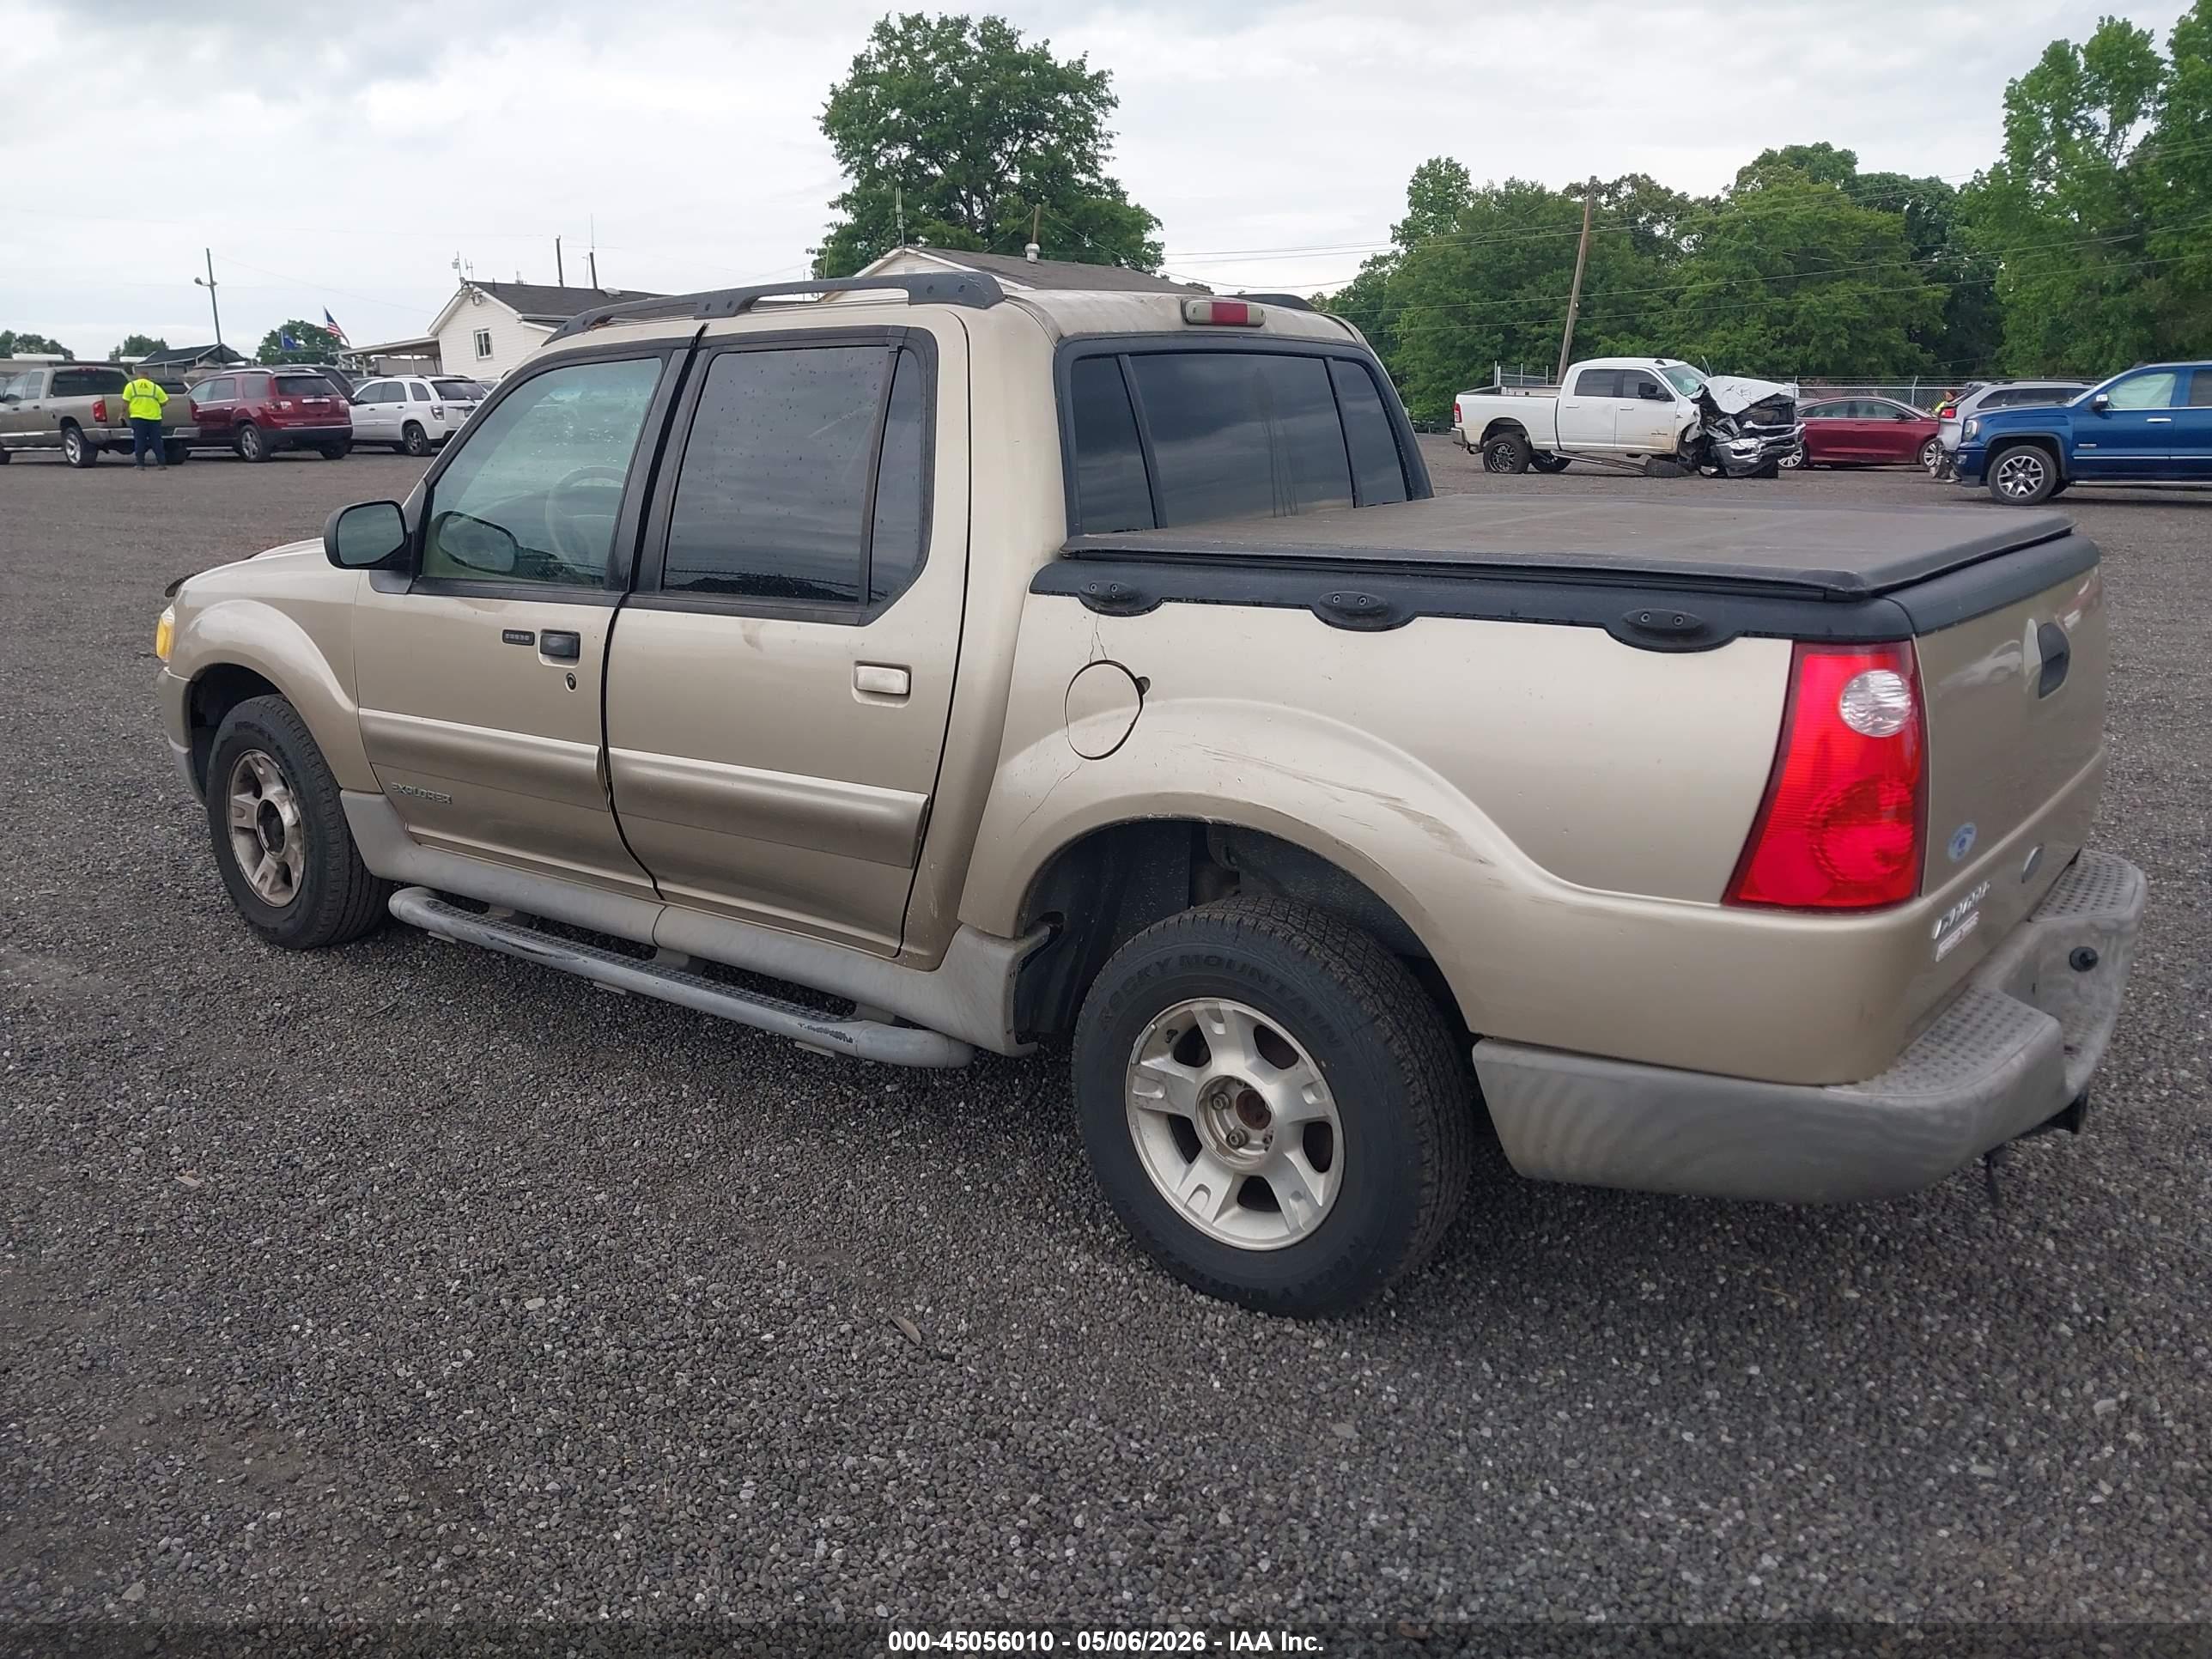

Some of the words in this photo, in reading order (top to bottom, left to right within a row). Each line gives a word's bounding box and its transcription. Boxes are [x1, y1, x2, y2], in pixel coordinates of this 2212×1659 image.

[391, 782, 453, 804] EXPLORER
[1097, 956, 1171, 1030] ROCKY
[1177, 953, 1342, 1049] MOUNTAIN
